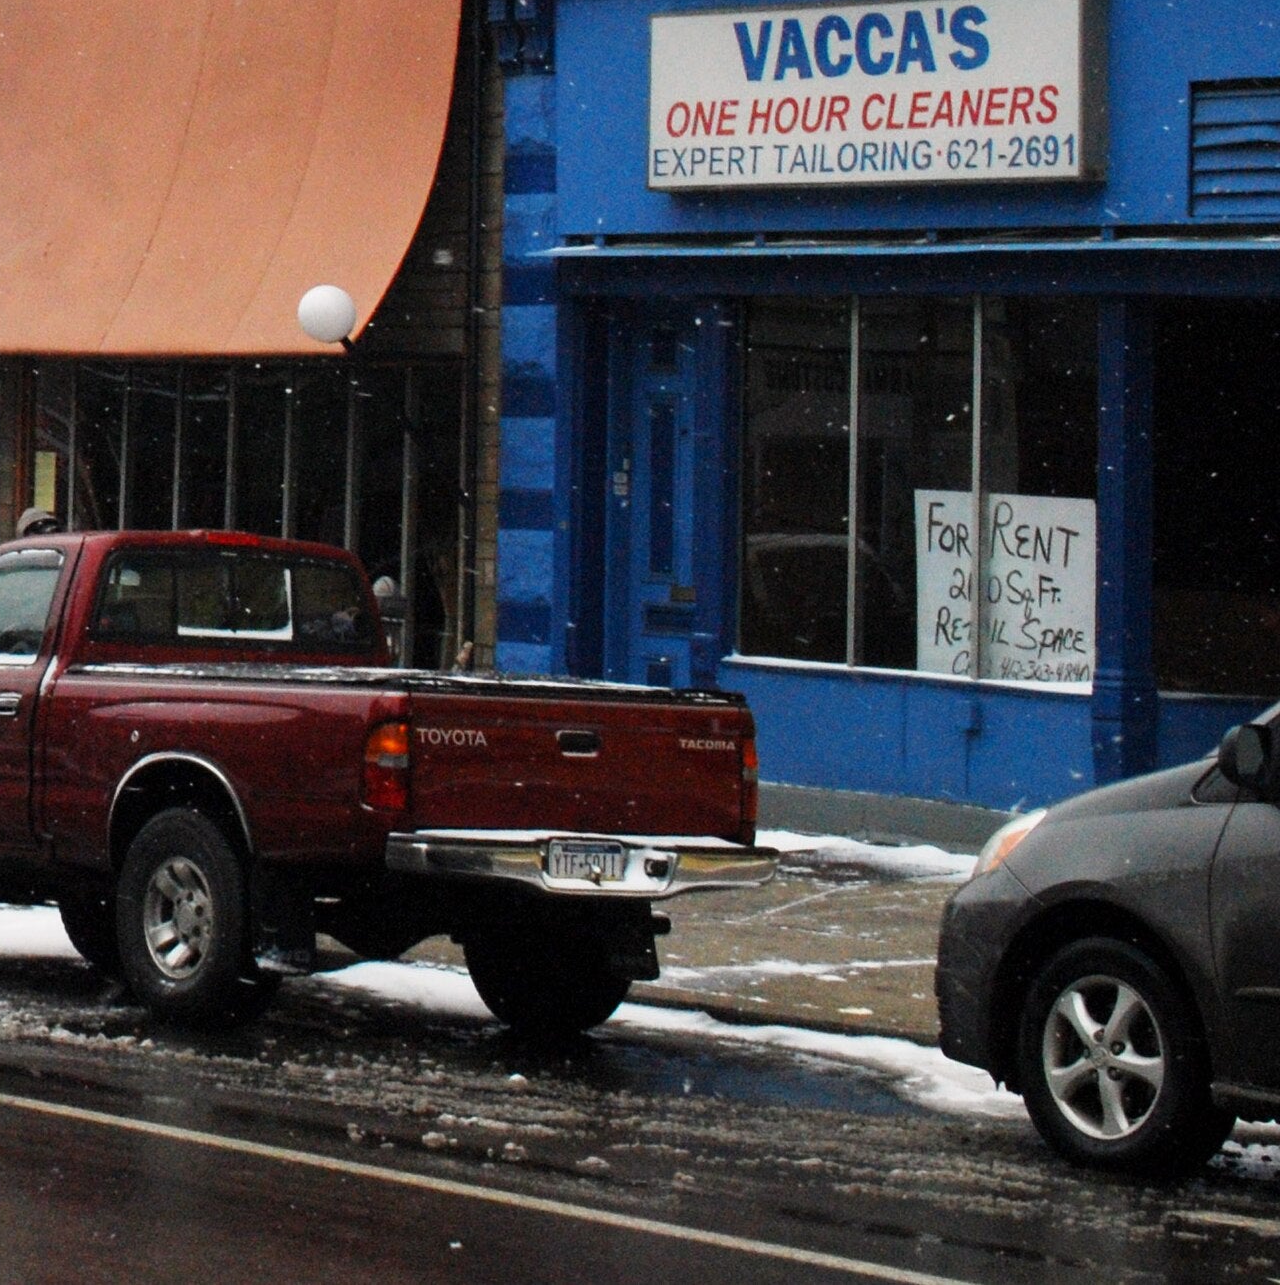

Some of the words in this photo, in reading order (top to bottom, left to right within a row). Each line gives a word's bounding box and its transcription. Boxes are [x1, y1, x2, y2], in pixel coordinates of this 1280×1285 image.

[733, 4, 991, 83] VACCA'S
[666, 99, 739, 138] ONE
[747, 94, 851, 135] HOUR
[861, 84, 1060, 130] CLEANERS
[653, 144, 765, 178] EXPERT
[774, 137, 933, 174] TAILORING
[945, 133, 1076, 170] 621-2691
[928, 502, 972, 558] FOR
[990, 500, 1080, 569] RENT
[416, 727, 487, 746] TOYOTA
[679, 737, 736, 751] TACOMA
